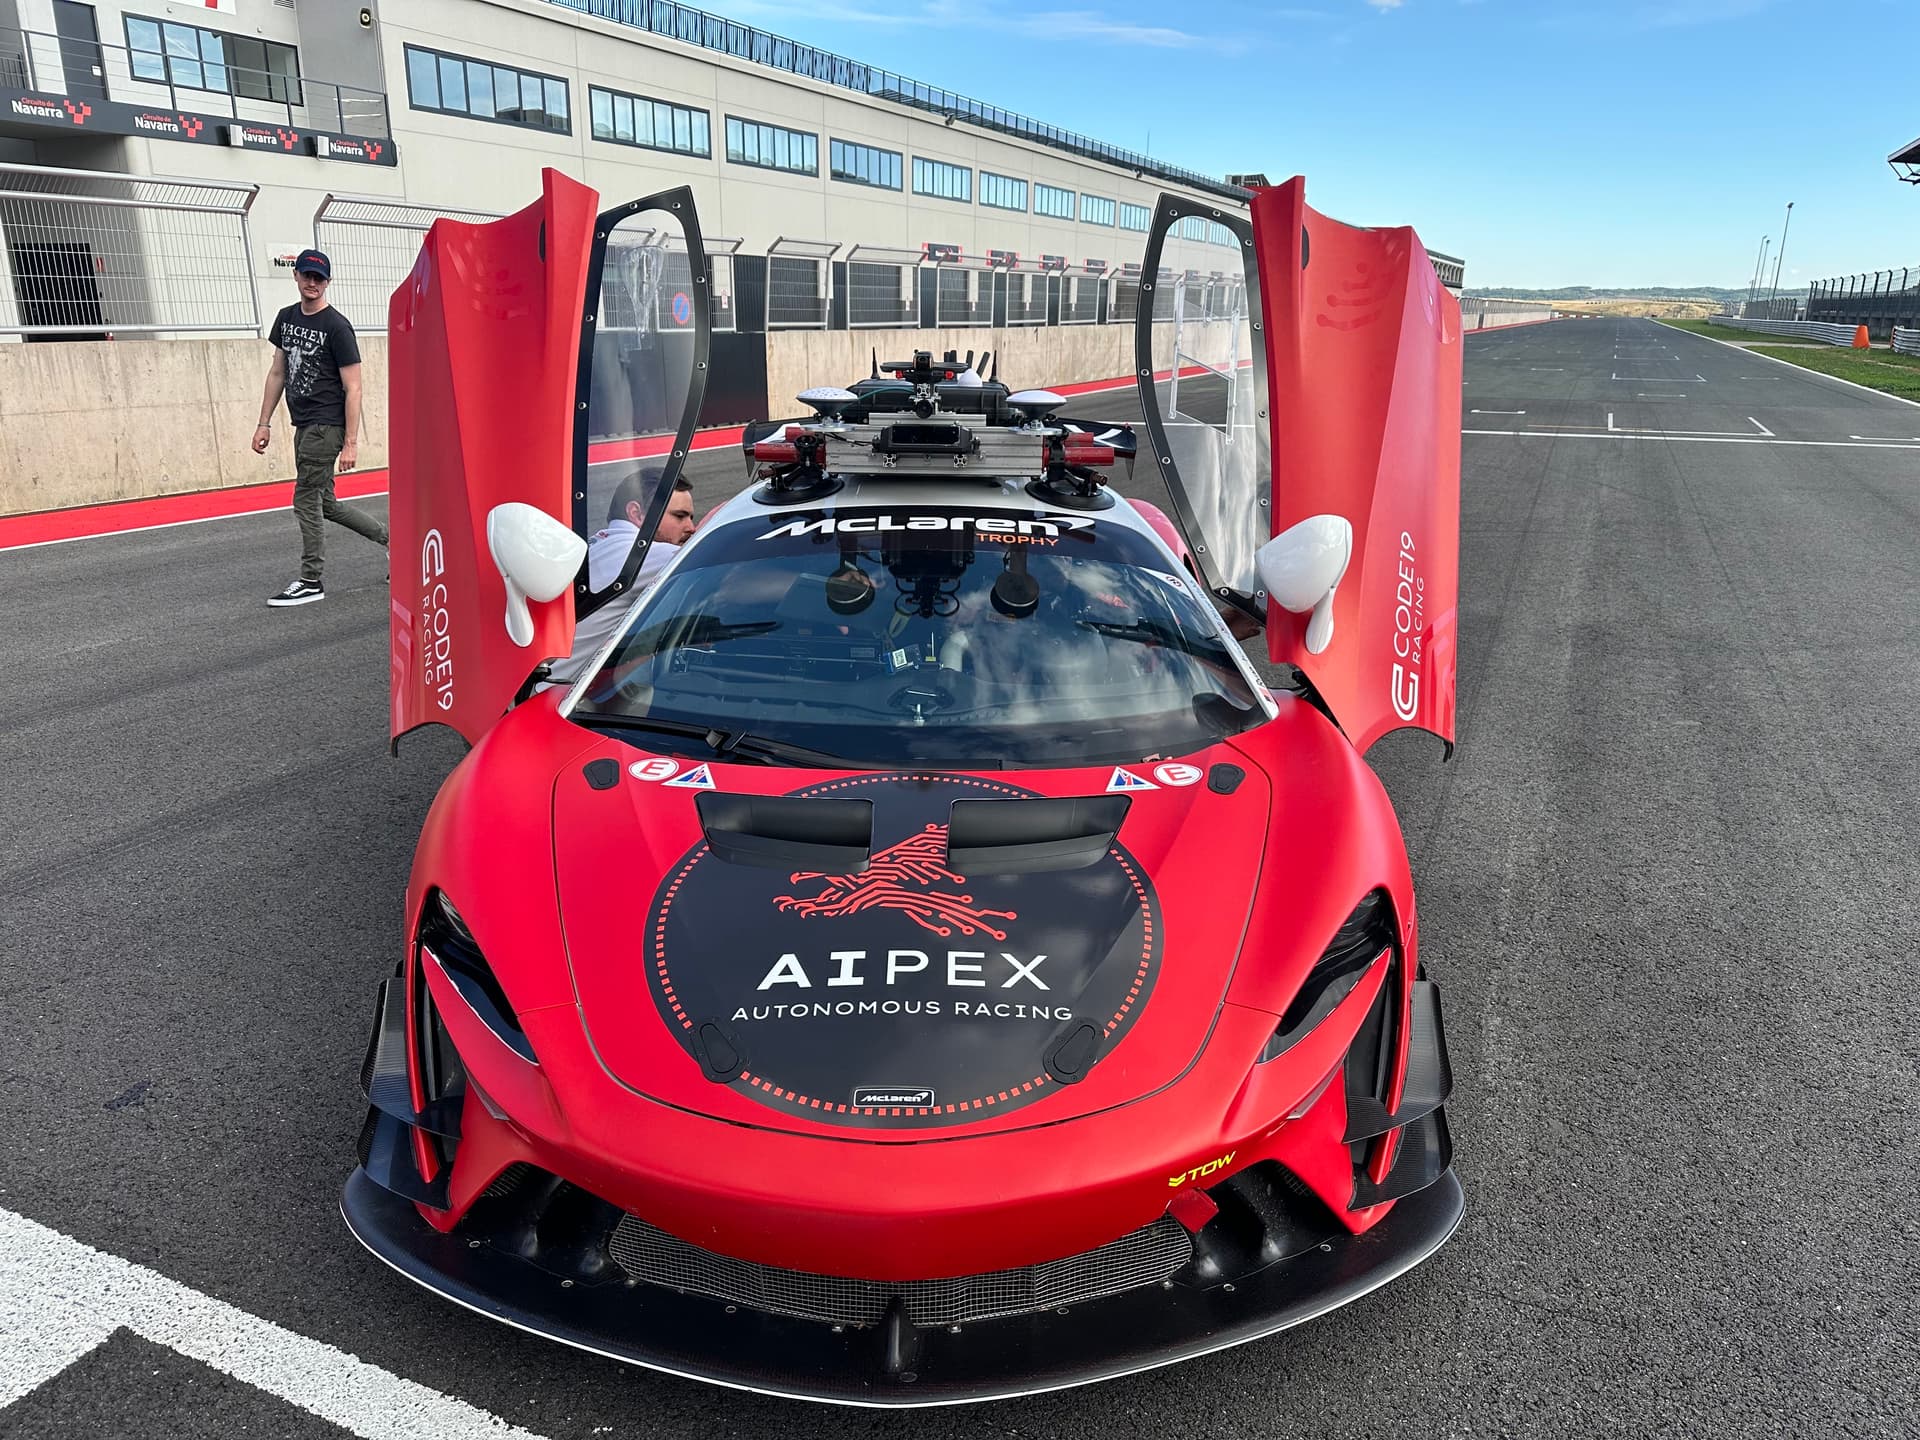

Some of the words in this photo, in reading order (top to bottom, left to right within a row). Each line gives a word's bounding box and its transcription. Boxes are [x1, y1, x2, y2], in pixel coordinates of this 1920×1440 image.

[11, 100, 64, 119] Navarra
[134, 116, 179, 133] Navarra
[329, 142, 363, 156] Navarra
[274, 257, 296, 268] Nava
[281, 322, 328, 346] WACKEN
[755, 516, 1062, 541] McLaren
[976, 533, 1059, 547] TROPHY
[1394, 531, 1416, 658] CODE19
[1412, 577, 1425, 665] RACING
[422, 595, 434, 686] RACING
[433, 583, 453, 711] CODE19
[756, 950, 1051, 991] AIPEX
[731, 1001, 941, 1021] AUTONOMOUS
[954, 1002, 1073, 1021] RACING
[860, 1094, 924, 1102] McLaren
[1187, 1150, 1237, 1180] TOW
